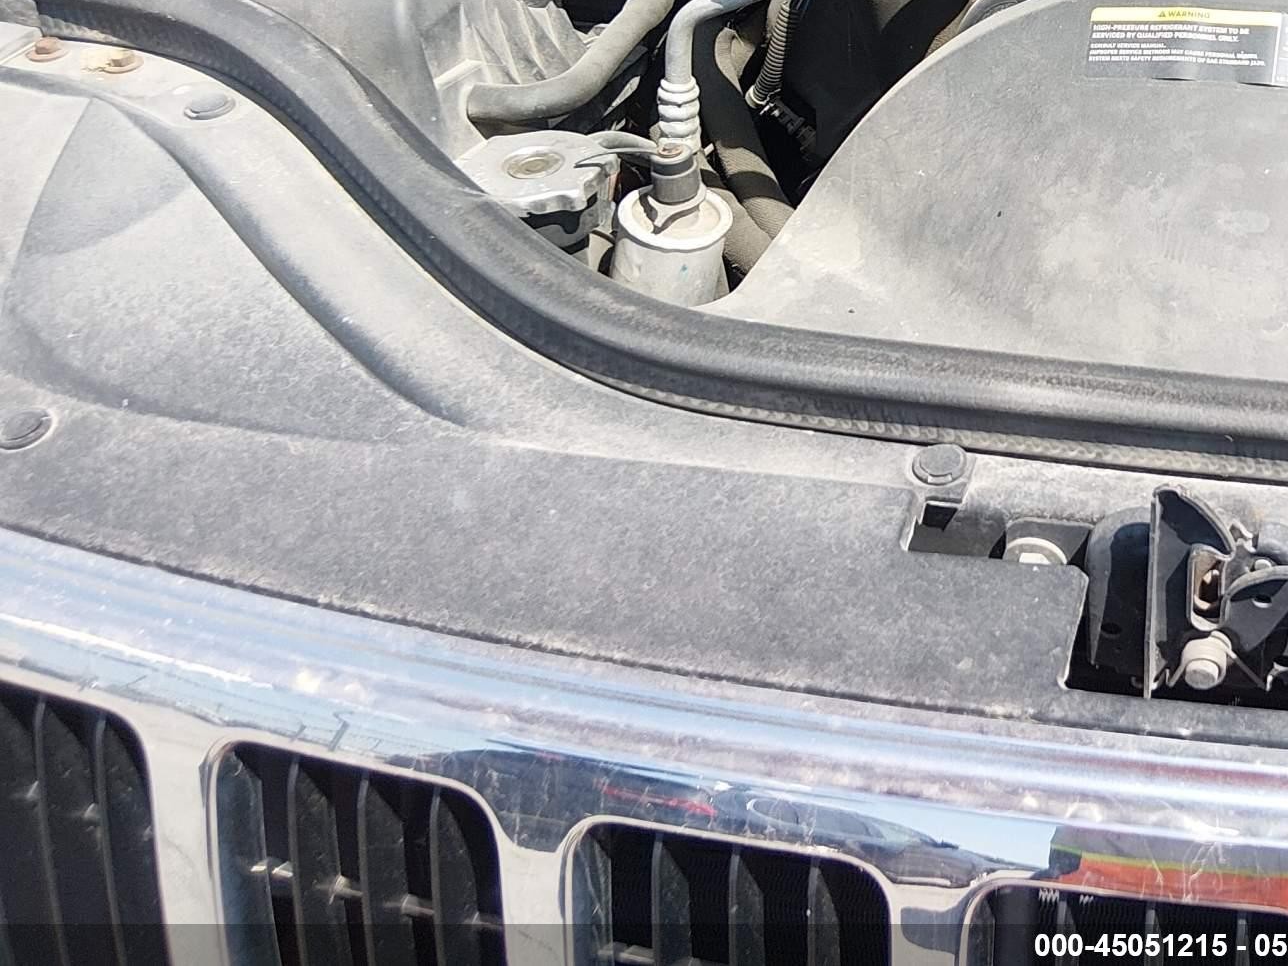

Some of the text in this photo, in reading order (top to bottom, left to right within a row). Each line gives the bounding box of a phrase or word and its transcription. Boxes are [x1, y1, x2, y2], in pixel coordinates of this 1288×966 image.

[1168, 10, 1210, 19] WARNING
[1150, 24, 1198, 32] REFRIGERANT
[1199, 26, 1227, 34] SYSTEM
[1092, 31, 1125, 39] SERVICED
[1126, 31, 1136, 39] BY
[1136, 31, 1173, 39] QUALIFIED
